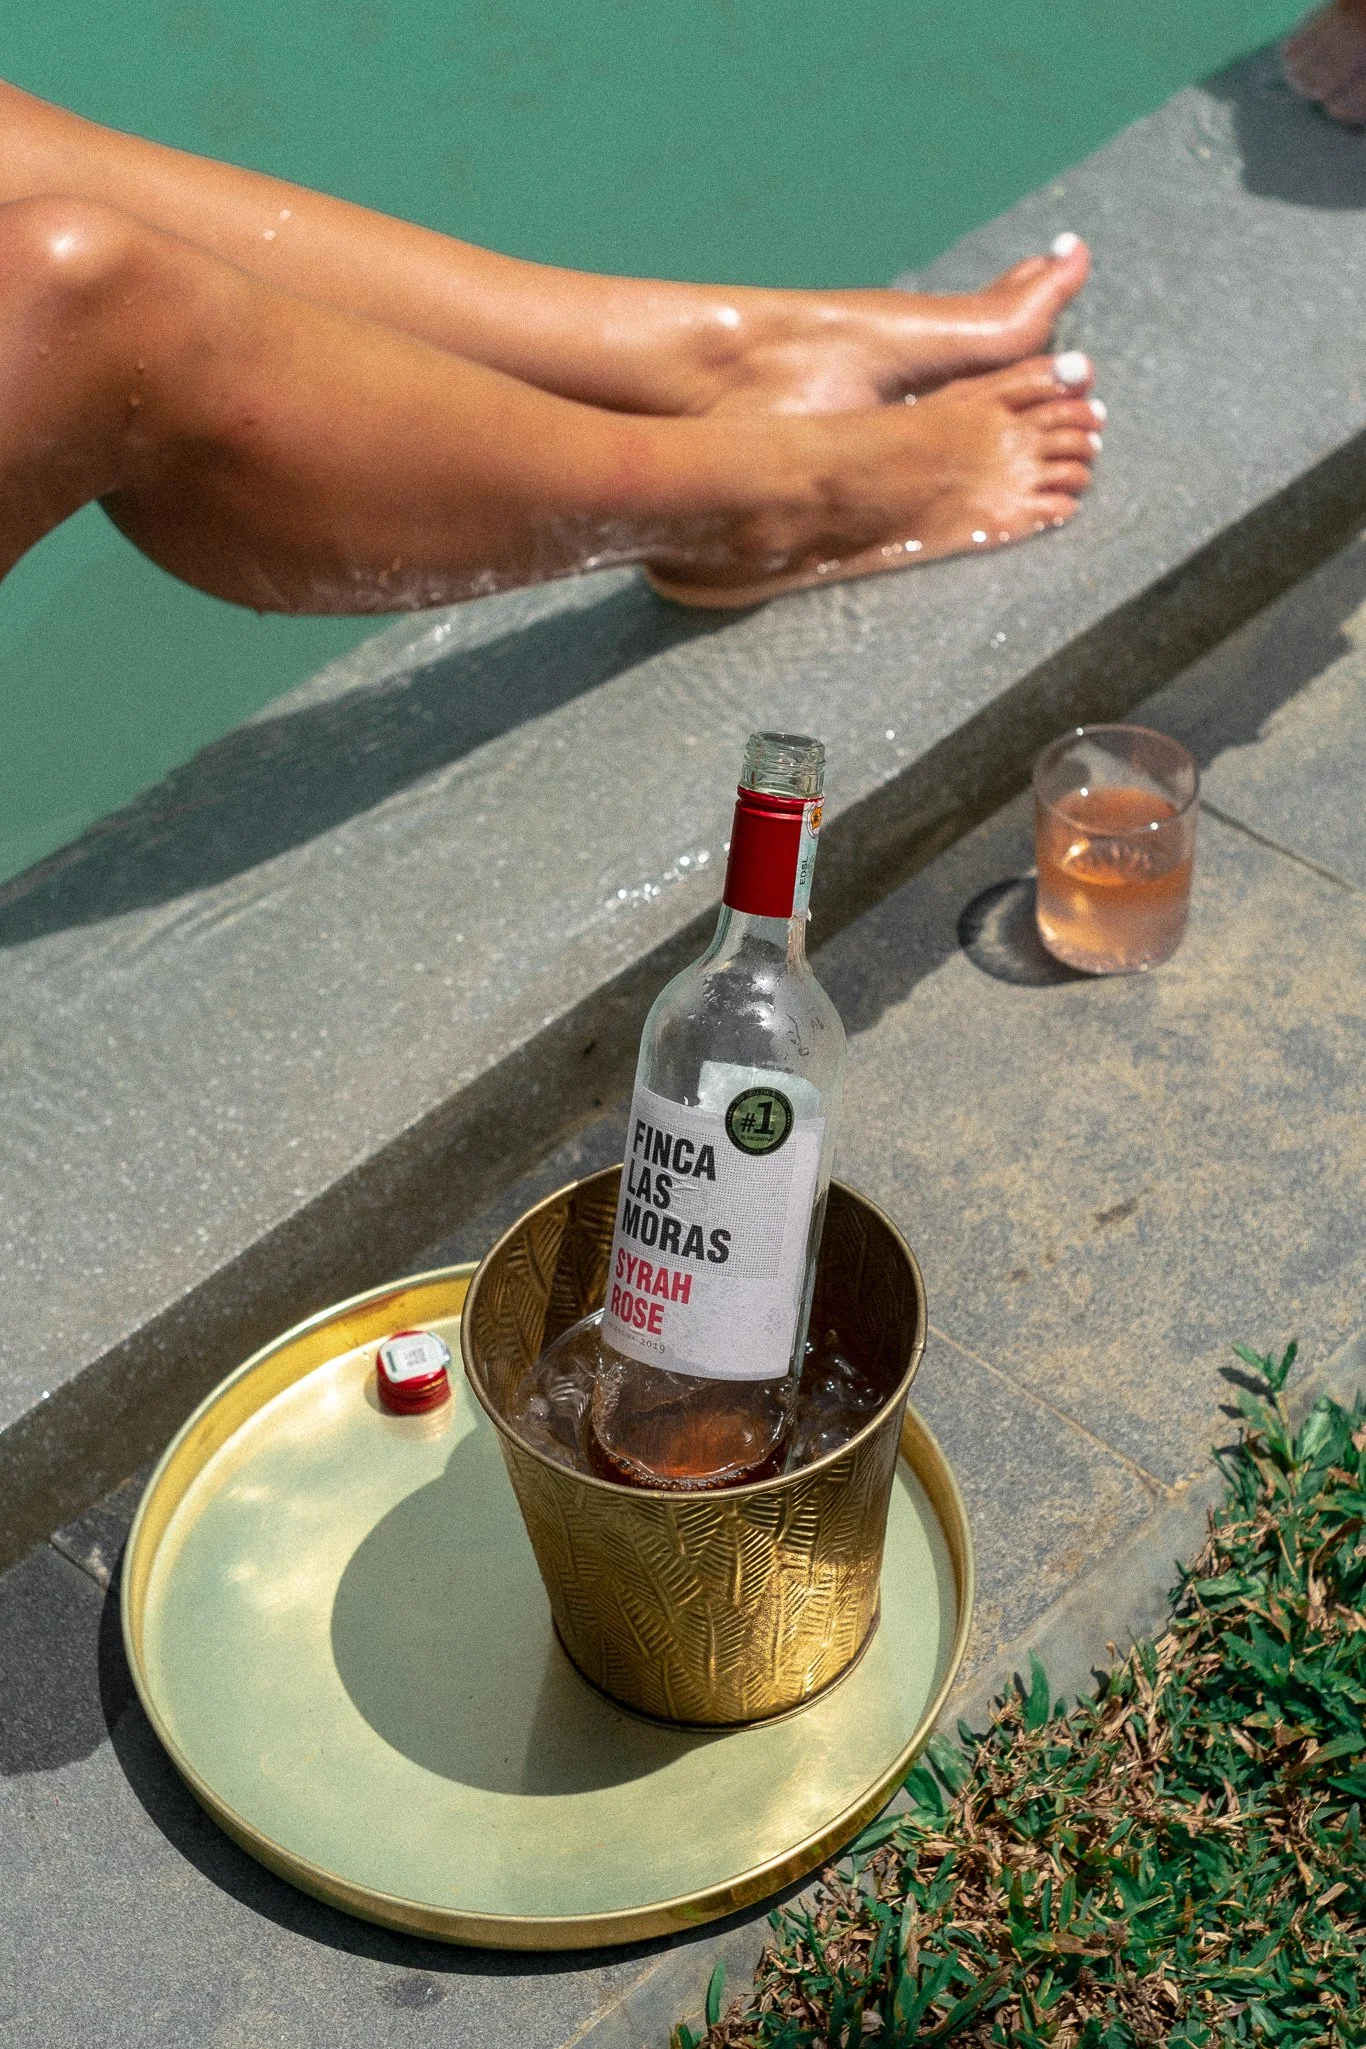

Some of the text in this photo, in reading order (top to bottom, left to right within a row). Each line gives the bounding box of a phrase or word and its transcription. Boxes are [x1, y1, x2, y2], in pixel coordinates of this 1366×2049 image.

[740, 1101, 774, 1134] #1
[633, 1119, 716, 1182] FINCA
[627, 1158, 673, 1210] LAS
[621, 1197, 732, 1264] MORAS
[615, 1247, 693, 1305] SYRAH
[610, 1283, 665, 1336] ROSE
[640, 1338, 666, 1354] 2019
